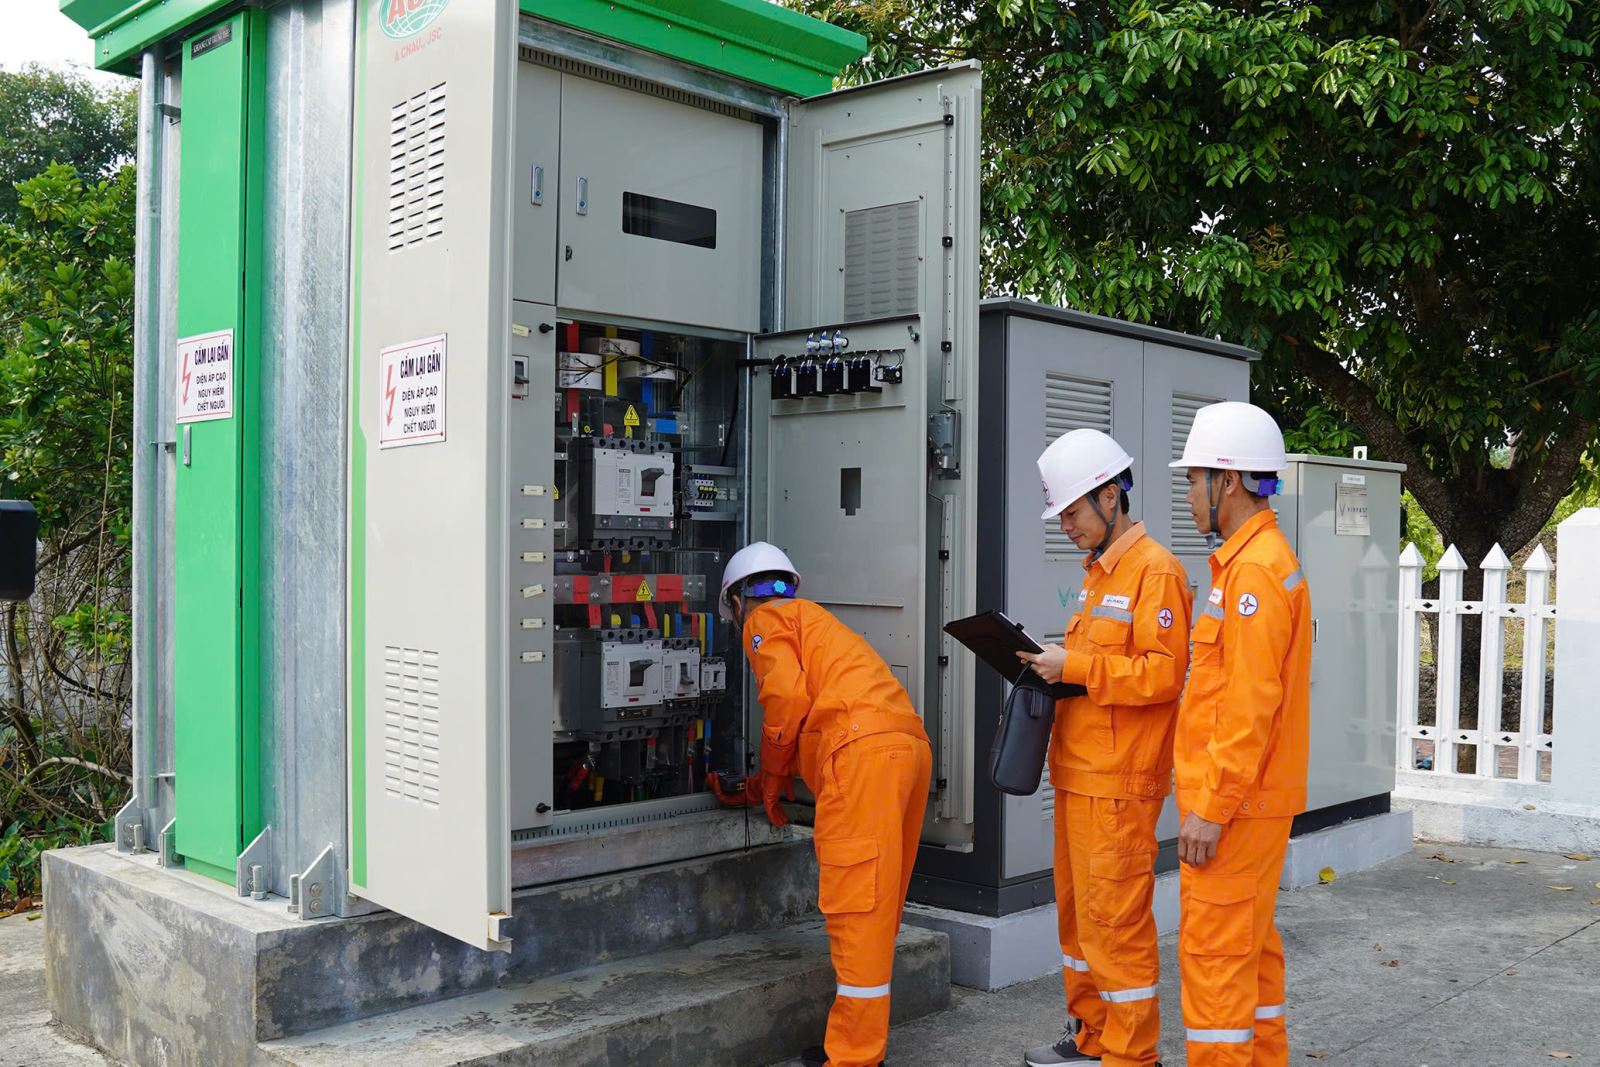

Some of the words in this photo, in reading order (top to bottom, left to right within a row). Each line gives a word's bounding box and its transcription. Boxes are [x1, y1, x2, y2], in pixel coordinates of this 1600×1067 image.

[208, 347, 216, 367] LẠI
[416, 355, 425, 379] LẠI
[216, 371, 226, 381] CAO
[198, 388, 211, 398] NGUY
[416, 386, 424, 398] ÁP
[425, 385, 438, 397] CAO
[404, 406, 420, 417] NGUY
